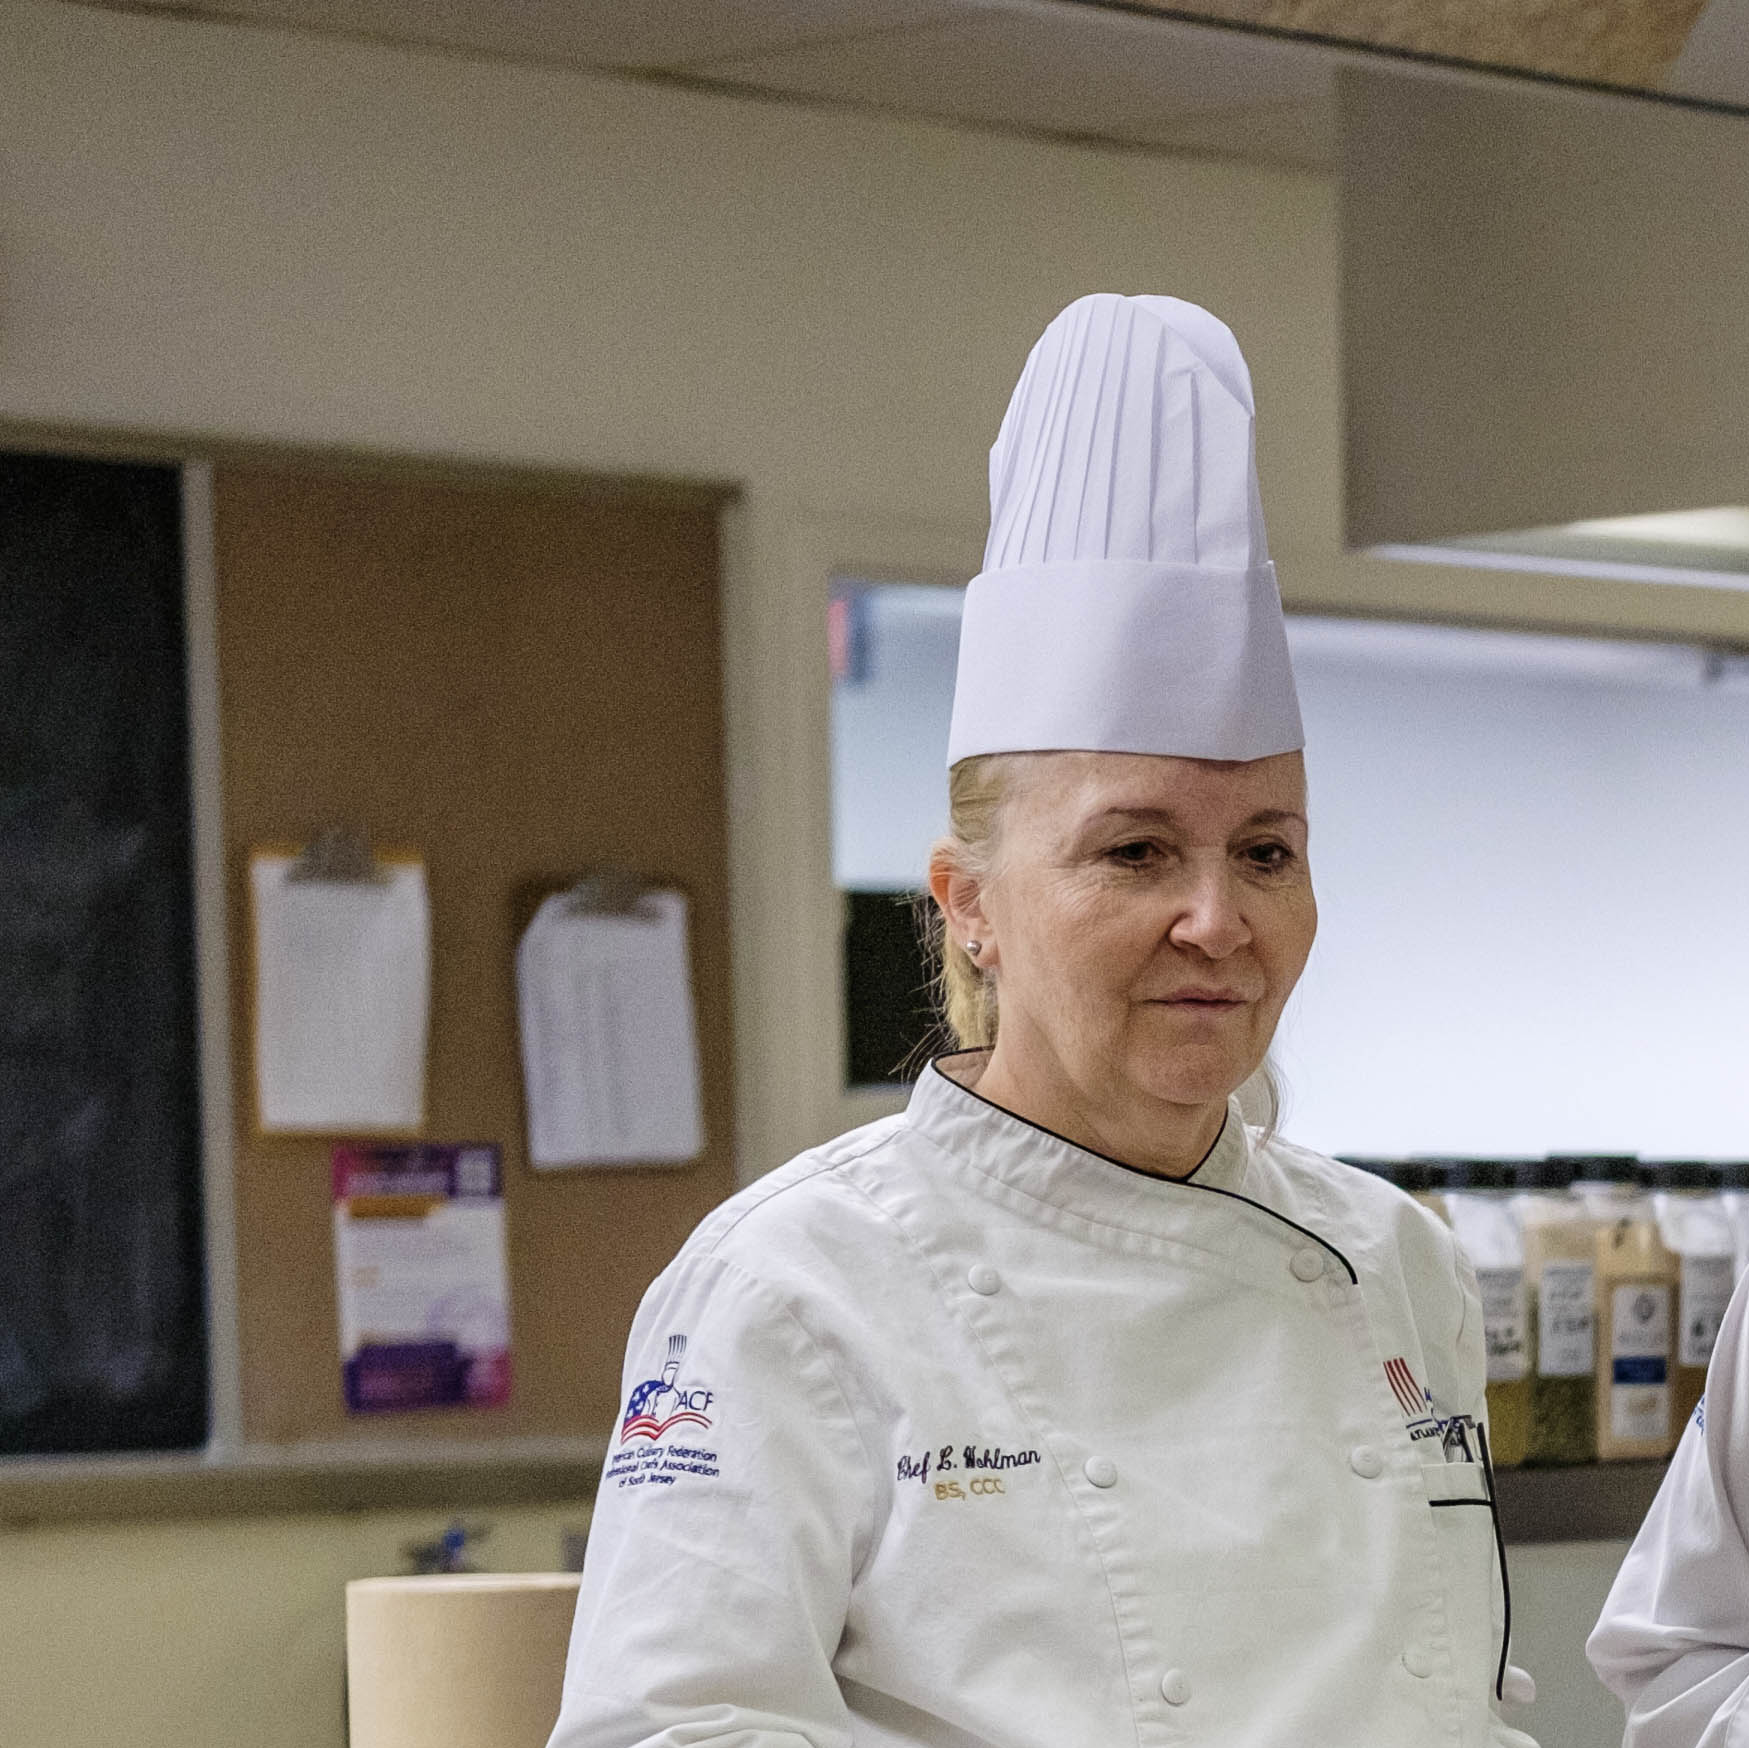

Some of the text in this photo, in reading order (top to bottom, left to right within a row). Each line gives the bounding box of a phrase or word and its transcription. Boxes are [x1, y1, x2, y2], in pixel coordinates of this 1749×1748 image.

[675, 1390, 714, 1412] ACF
[667, 1444, 717, 1463] Federation
[660, 1460, 720, 1477] Association
